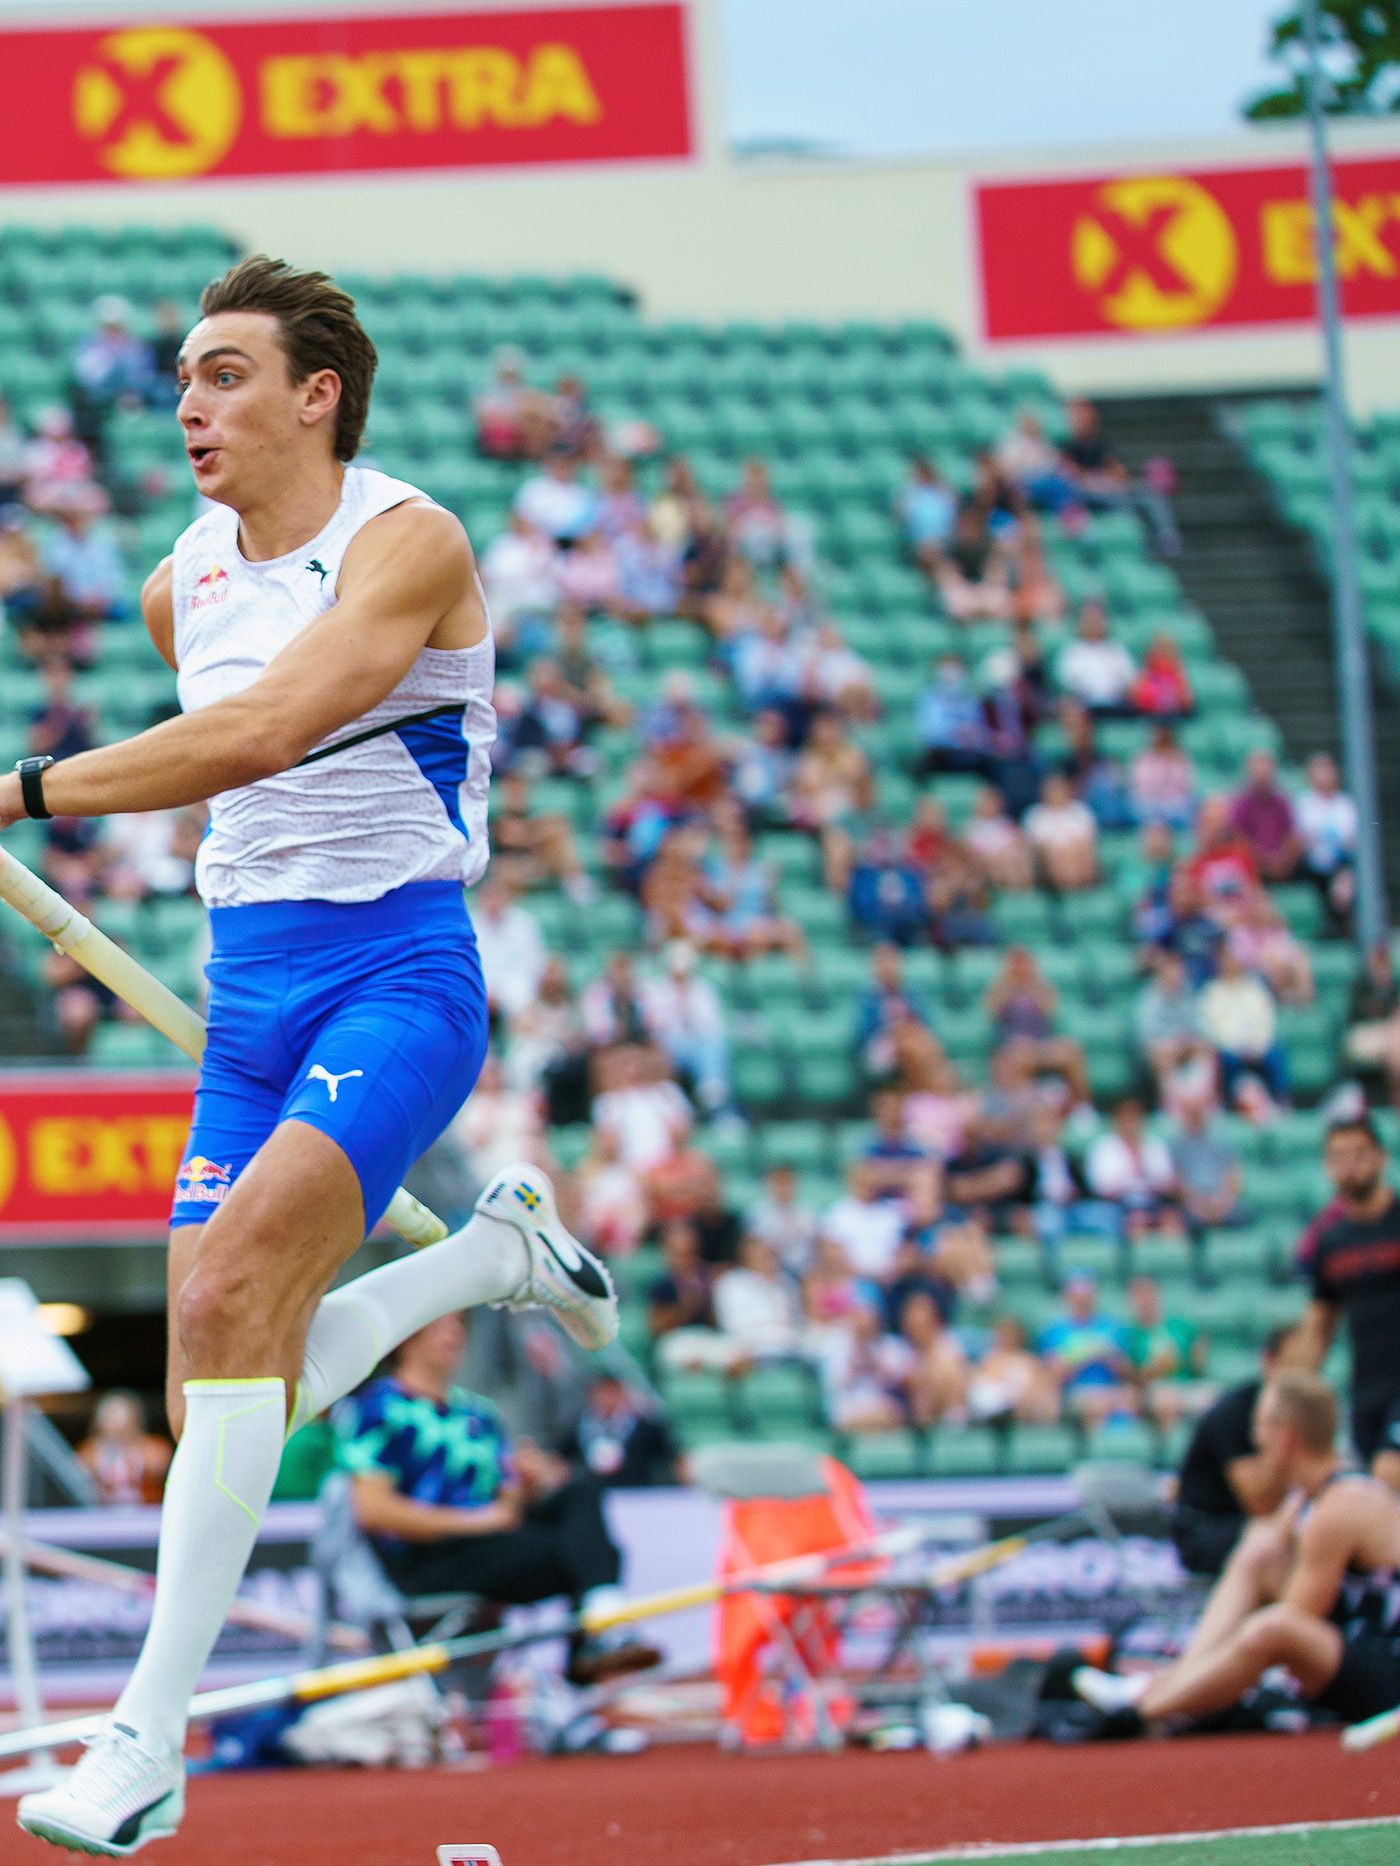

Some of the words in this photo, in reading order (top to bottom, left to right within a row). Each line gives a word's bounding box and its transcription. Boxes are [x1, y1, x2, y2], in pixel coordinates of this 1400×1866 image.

[260, 43, 602, 139] EXTRA
[175, 1182, 194, 1202] ed
[194, 1183, 230, 1202] Bull
